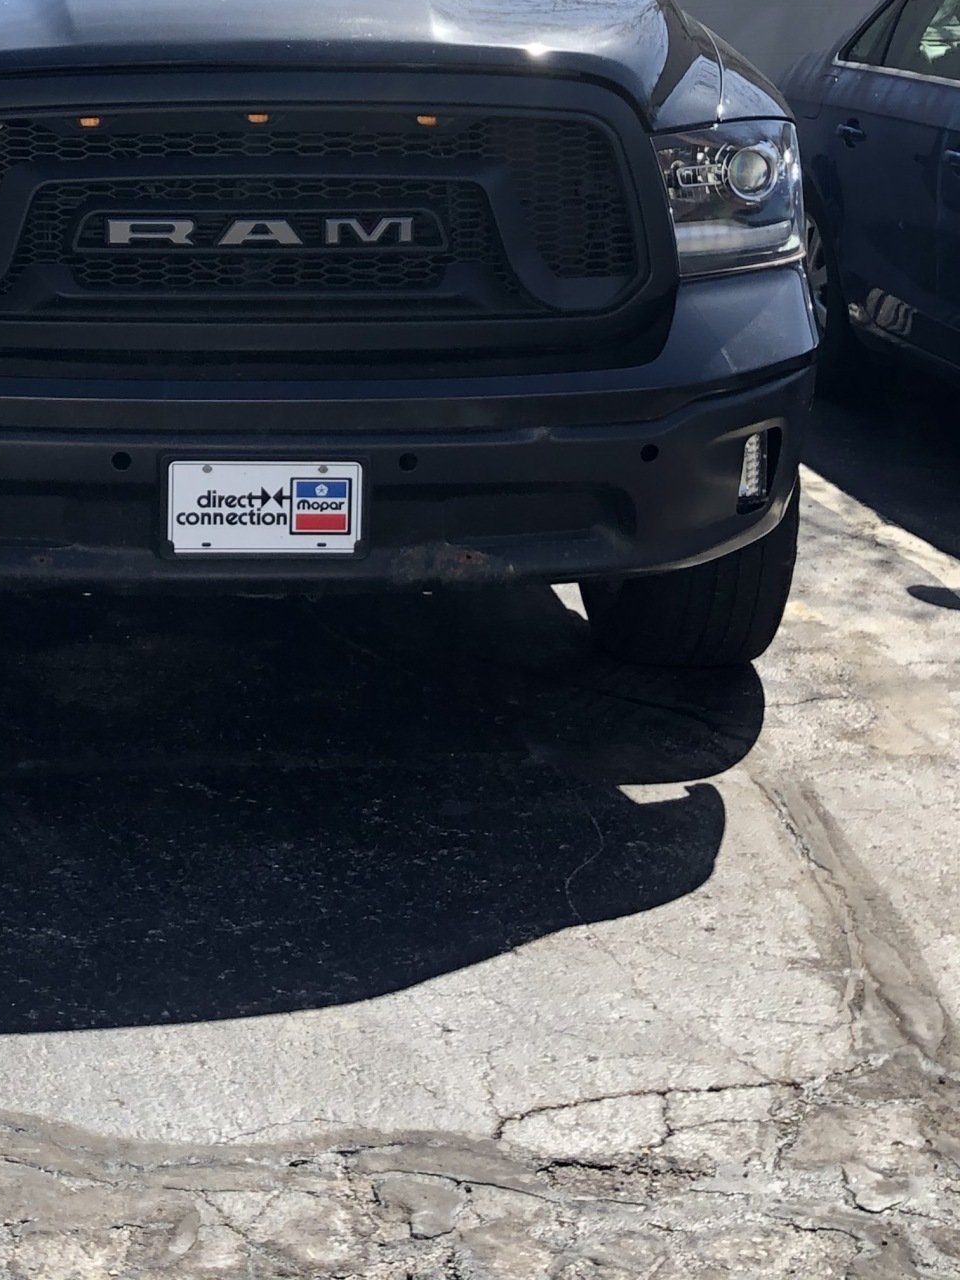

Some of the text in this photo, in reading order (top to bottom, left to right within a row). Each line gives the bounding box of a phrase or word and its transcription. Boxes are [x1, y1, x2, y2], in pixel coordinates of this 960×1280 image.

[108, 217, 413, 245] RAM
[196, 490, 255, 508] direct
[176, 508, 287, 526] connection
